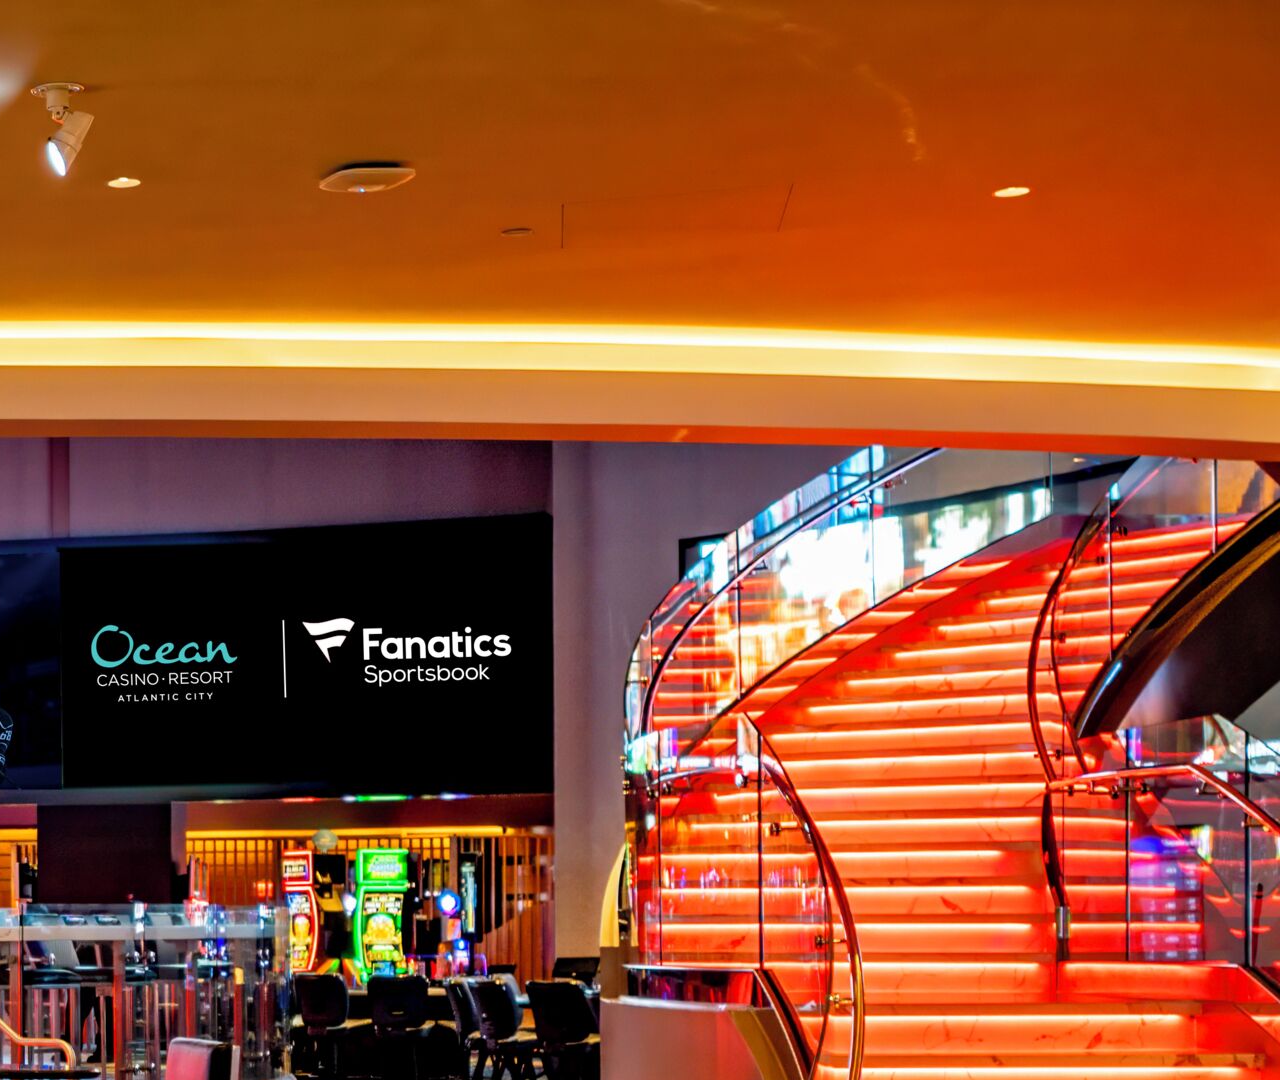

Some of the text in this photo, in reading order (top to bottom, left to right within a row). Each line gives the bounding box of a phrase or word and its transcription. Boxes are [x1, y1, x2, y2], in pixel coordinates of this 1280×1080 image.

[91, 624, 238, 668] Ocean
[362, 626, 512, 660] Fanatics
[364, 664, 490, 687] Sportsbook
[117, 692, 213, 702] ATLANTIC CITY
